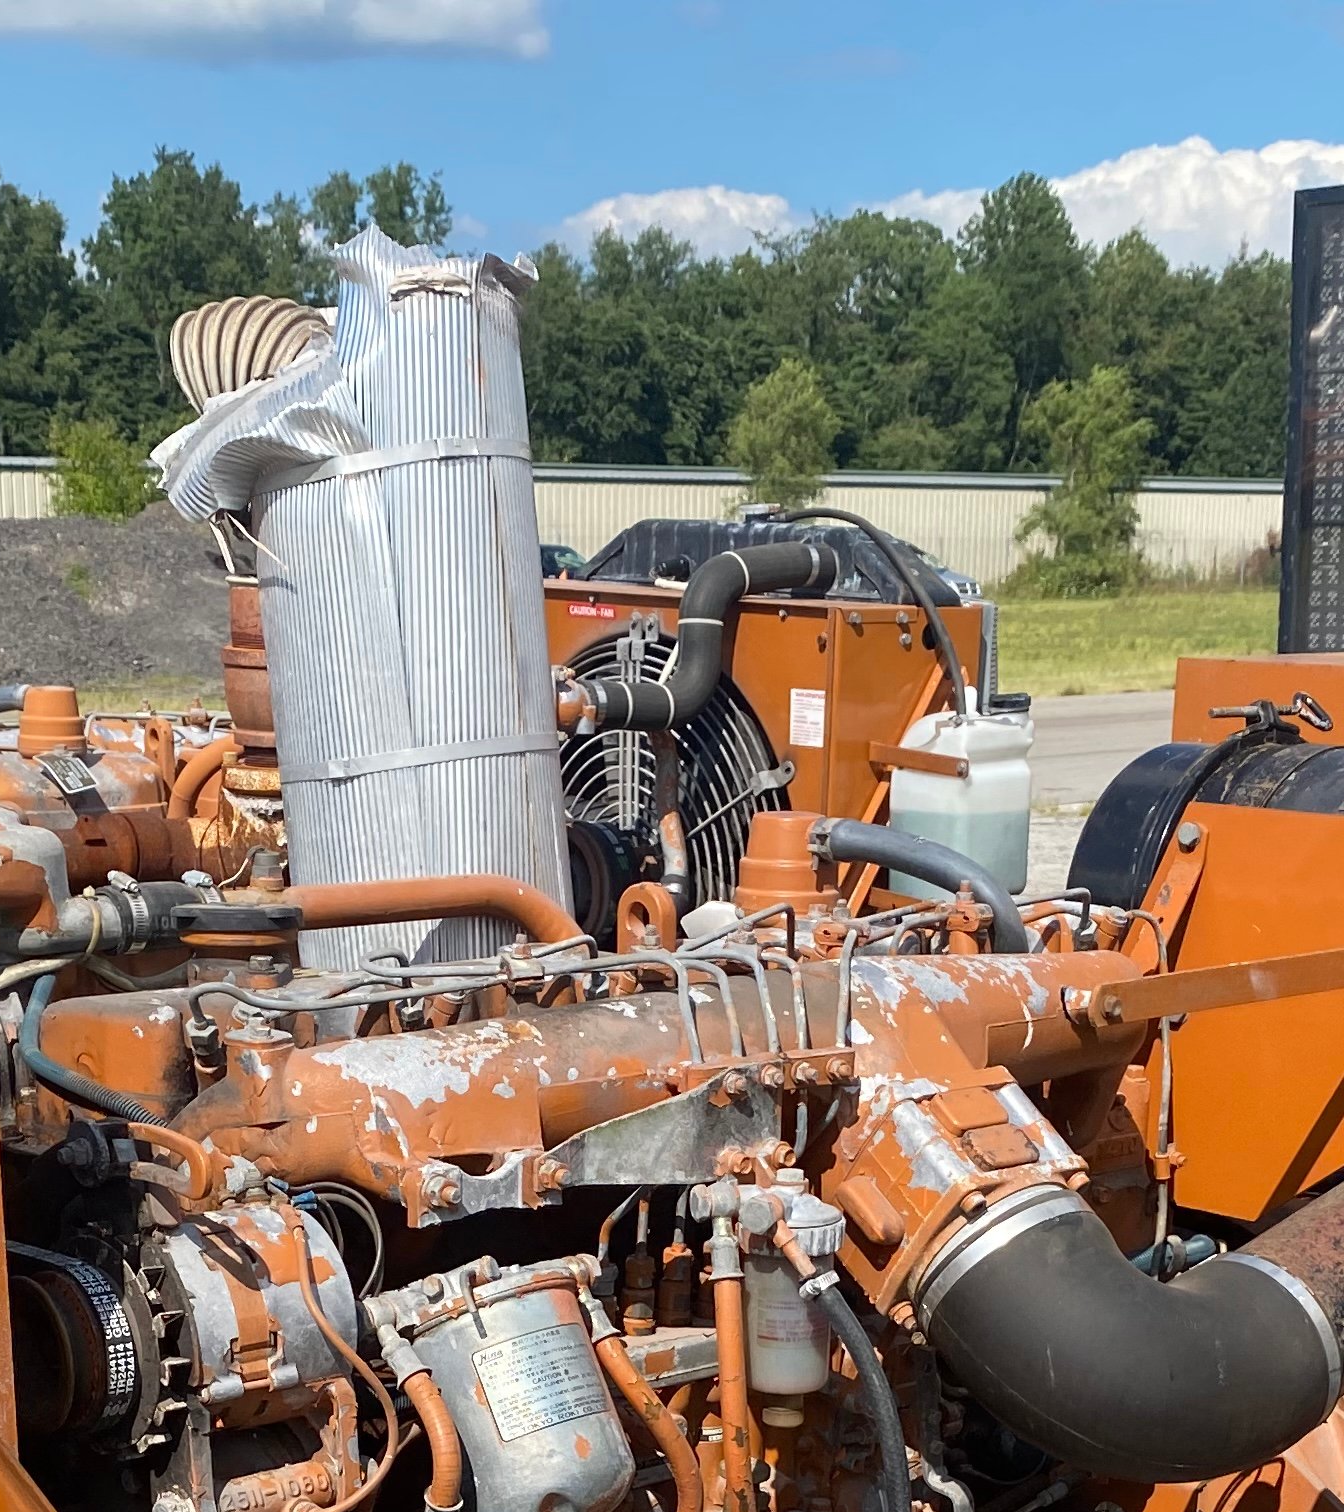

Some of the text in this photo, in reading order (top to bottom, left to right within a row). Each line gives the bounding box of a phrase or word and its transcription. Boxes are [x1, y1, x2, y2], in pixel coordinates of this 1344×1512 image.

[99, 1295, 123, 1338] GREEN
[116, 1343, 127, 1396] TR24414
[125, 1341, 135, 1394] TR24414
[532, 1372, 562, 1385] CAUTION
